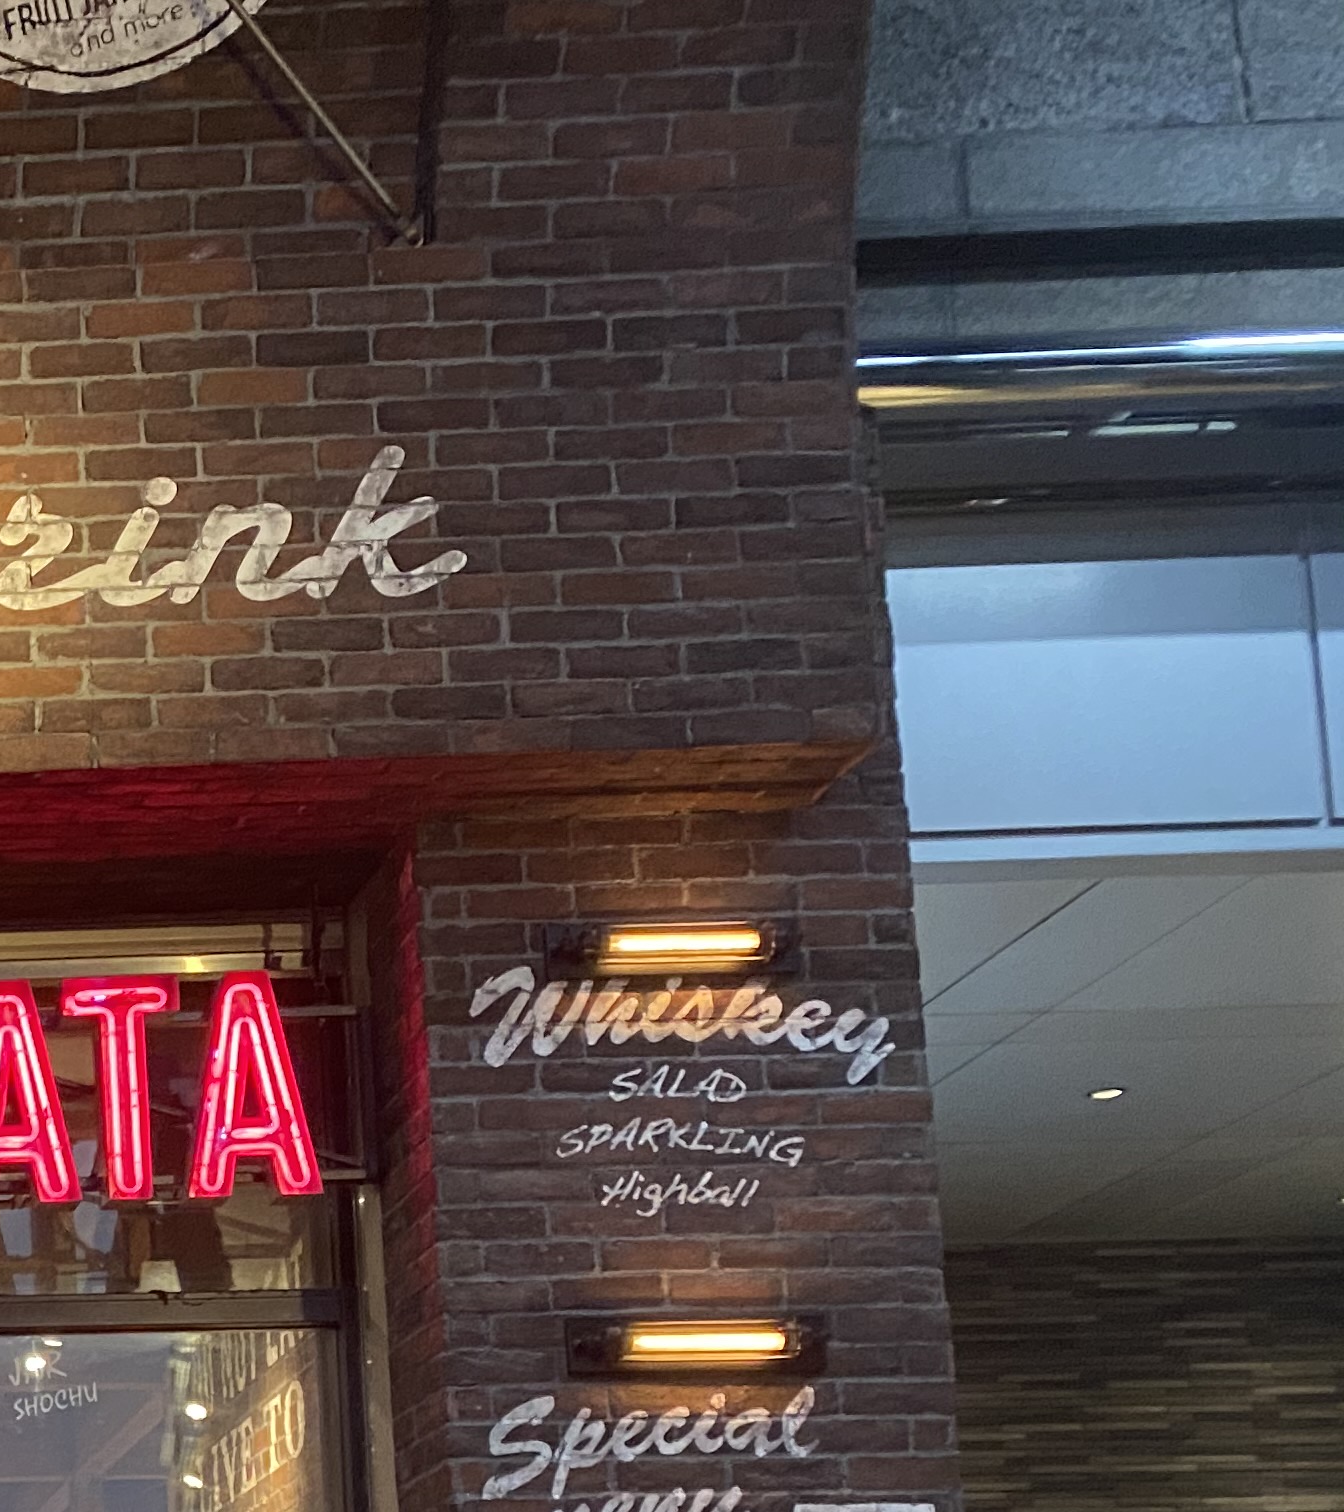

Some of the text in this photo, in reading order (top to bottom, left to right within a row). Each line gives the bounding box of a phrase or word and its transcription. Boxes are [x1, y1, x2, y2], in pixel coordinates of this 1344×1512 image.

[70, 3, 184, 57] and more
[469, 965, 896, 1086] Whiskey
[609, 1065, 747, 1103] SALAD
[556, 1118, 805, 1168] SPARKLING
[600, 1171, 760, 1218] Highball
[8, 1352, 67, 1386] JAR
[14, 1381, 99, 1420] SHOCHU
[264, 1380, 306, 1474] TO
[482, 1385, 820, 1500] Special
